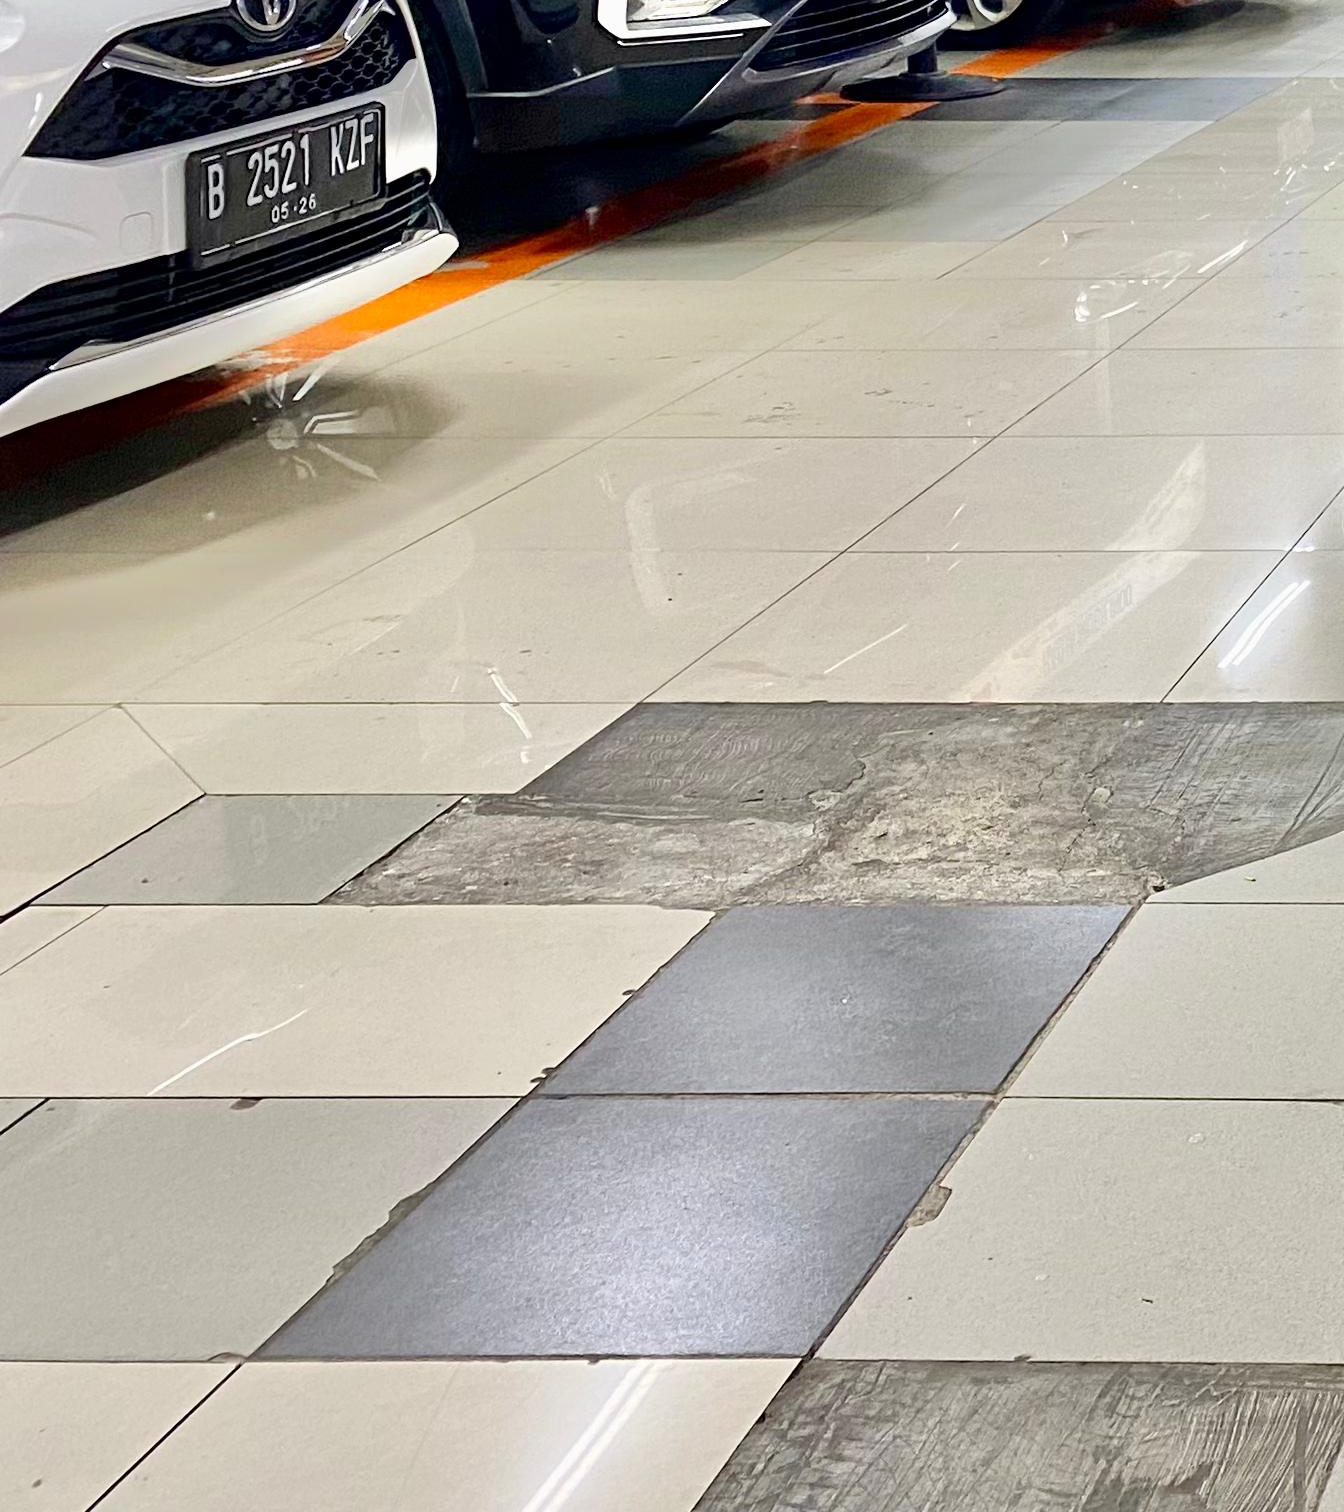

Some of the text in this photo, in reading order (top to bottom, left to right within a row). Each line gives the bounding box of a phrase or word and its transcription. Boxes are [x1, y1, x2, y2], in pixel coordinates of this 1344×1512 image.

[207, 112, 375, 220] B 2521 KZF
